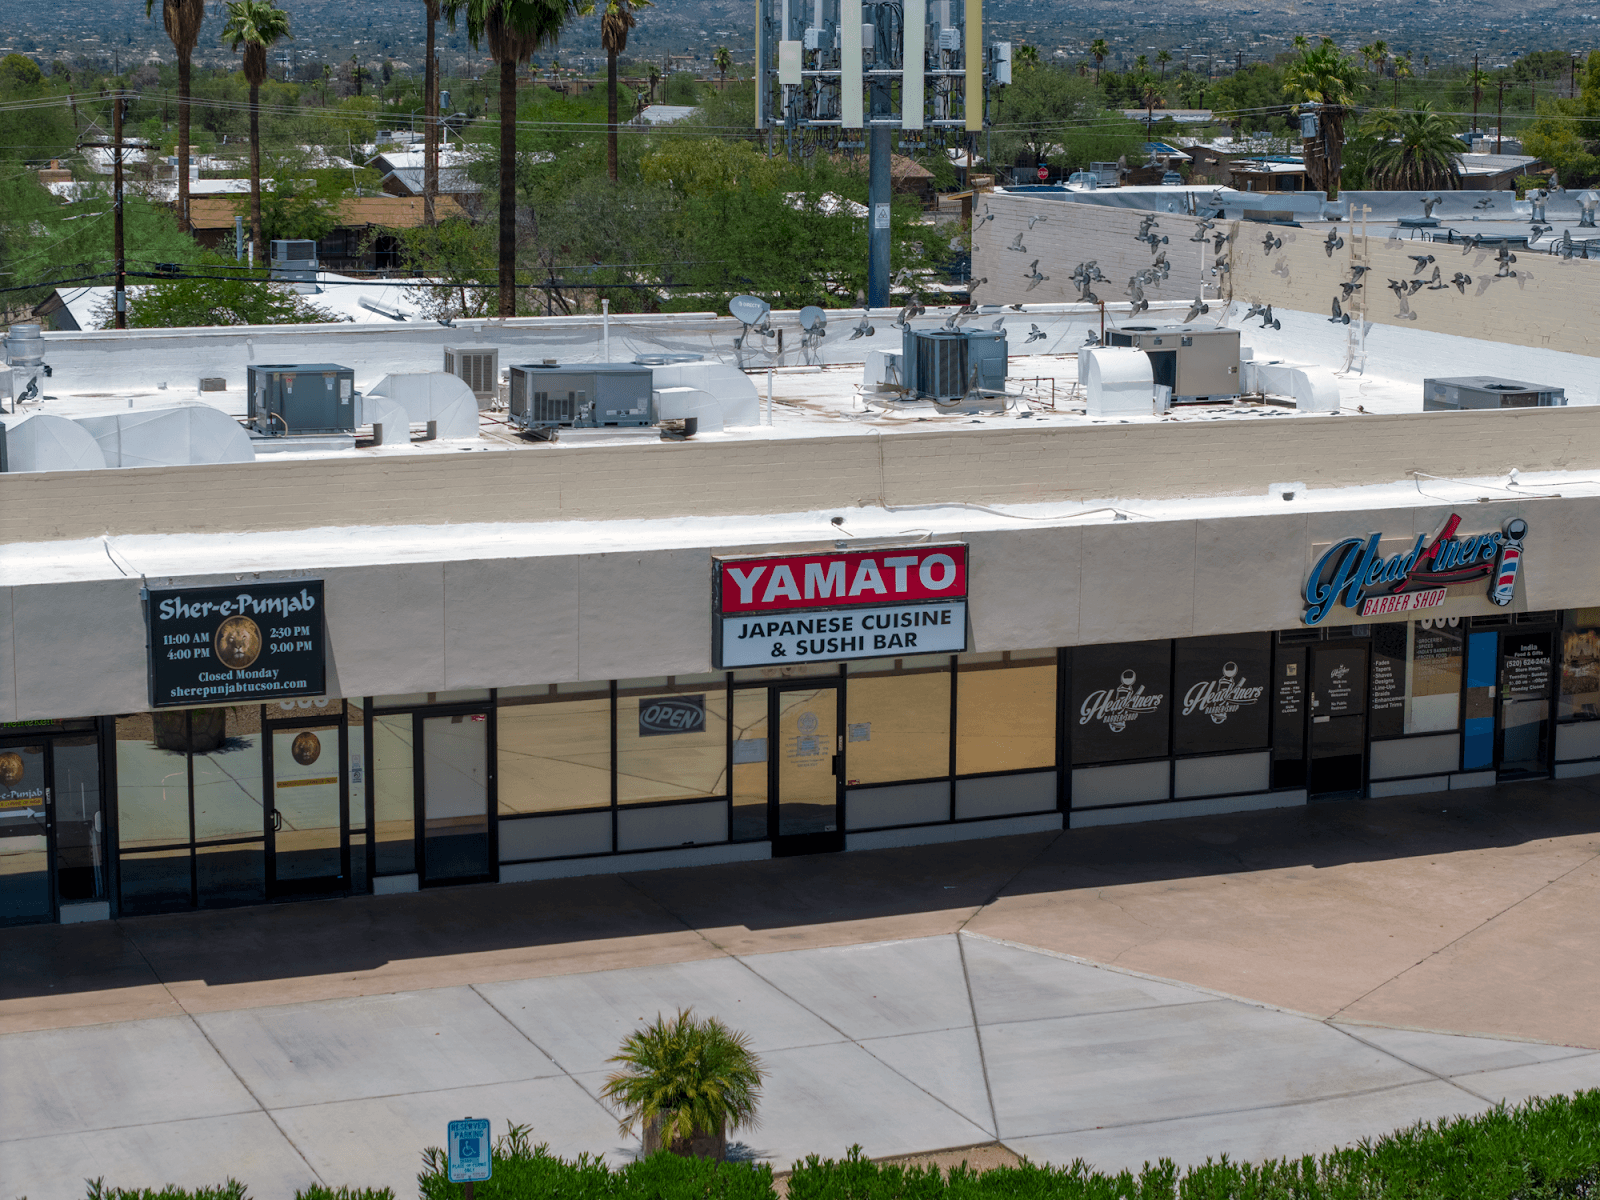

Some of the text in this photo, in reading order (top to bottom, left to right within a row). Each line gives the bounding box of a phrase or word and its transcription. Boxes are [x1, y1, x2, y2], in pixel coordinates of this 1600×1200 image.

[726, 553, 956, 605] YAMATO
[159, 588, 315, 620] Sher-e-Punjab
[1363, 589, 1445, 616] BARBER SHOP
[738, 609, 951, 640] JAPANESE CUISINE
[270, 625, 310, 638] 2:30 PM
[163, 632, 210, 645] 11:00 AM
[771, 632, 918, 658] & SUSHI BAR
[296, 641, 313, 651] PM
[167, 648, 210, 660] 4:00 PM
[1506, 660, 1522, 668] (520)
[198, 668, 279, 682] Closed Monday
[170, 680, 307, 698] sherepunjabtucson.com
[1204, 703, 1240, 714] BARBER SHOP
[643, 705, 697, 729] OPEN
[1103, 711, 1139, 724] BARBER SHOP
[451, 1122, 487, 1131] RESERVED
[454, 1130, 484, 1139] PARKING
